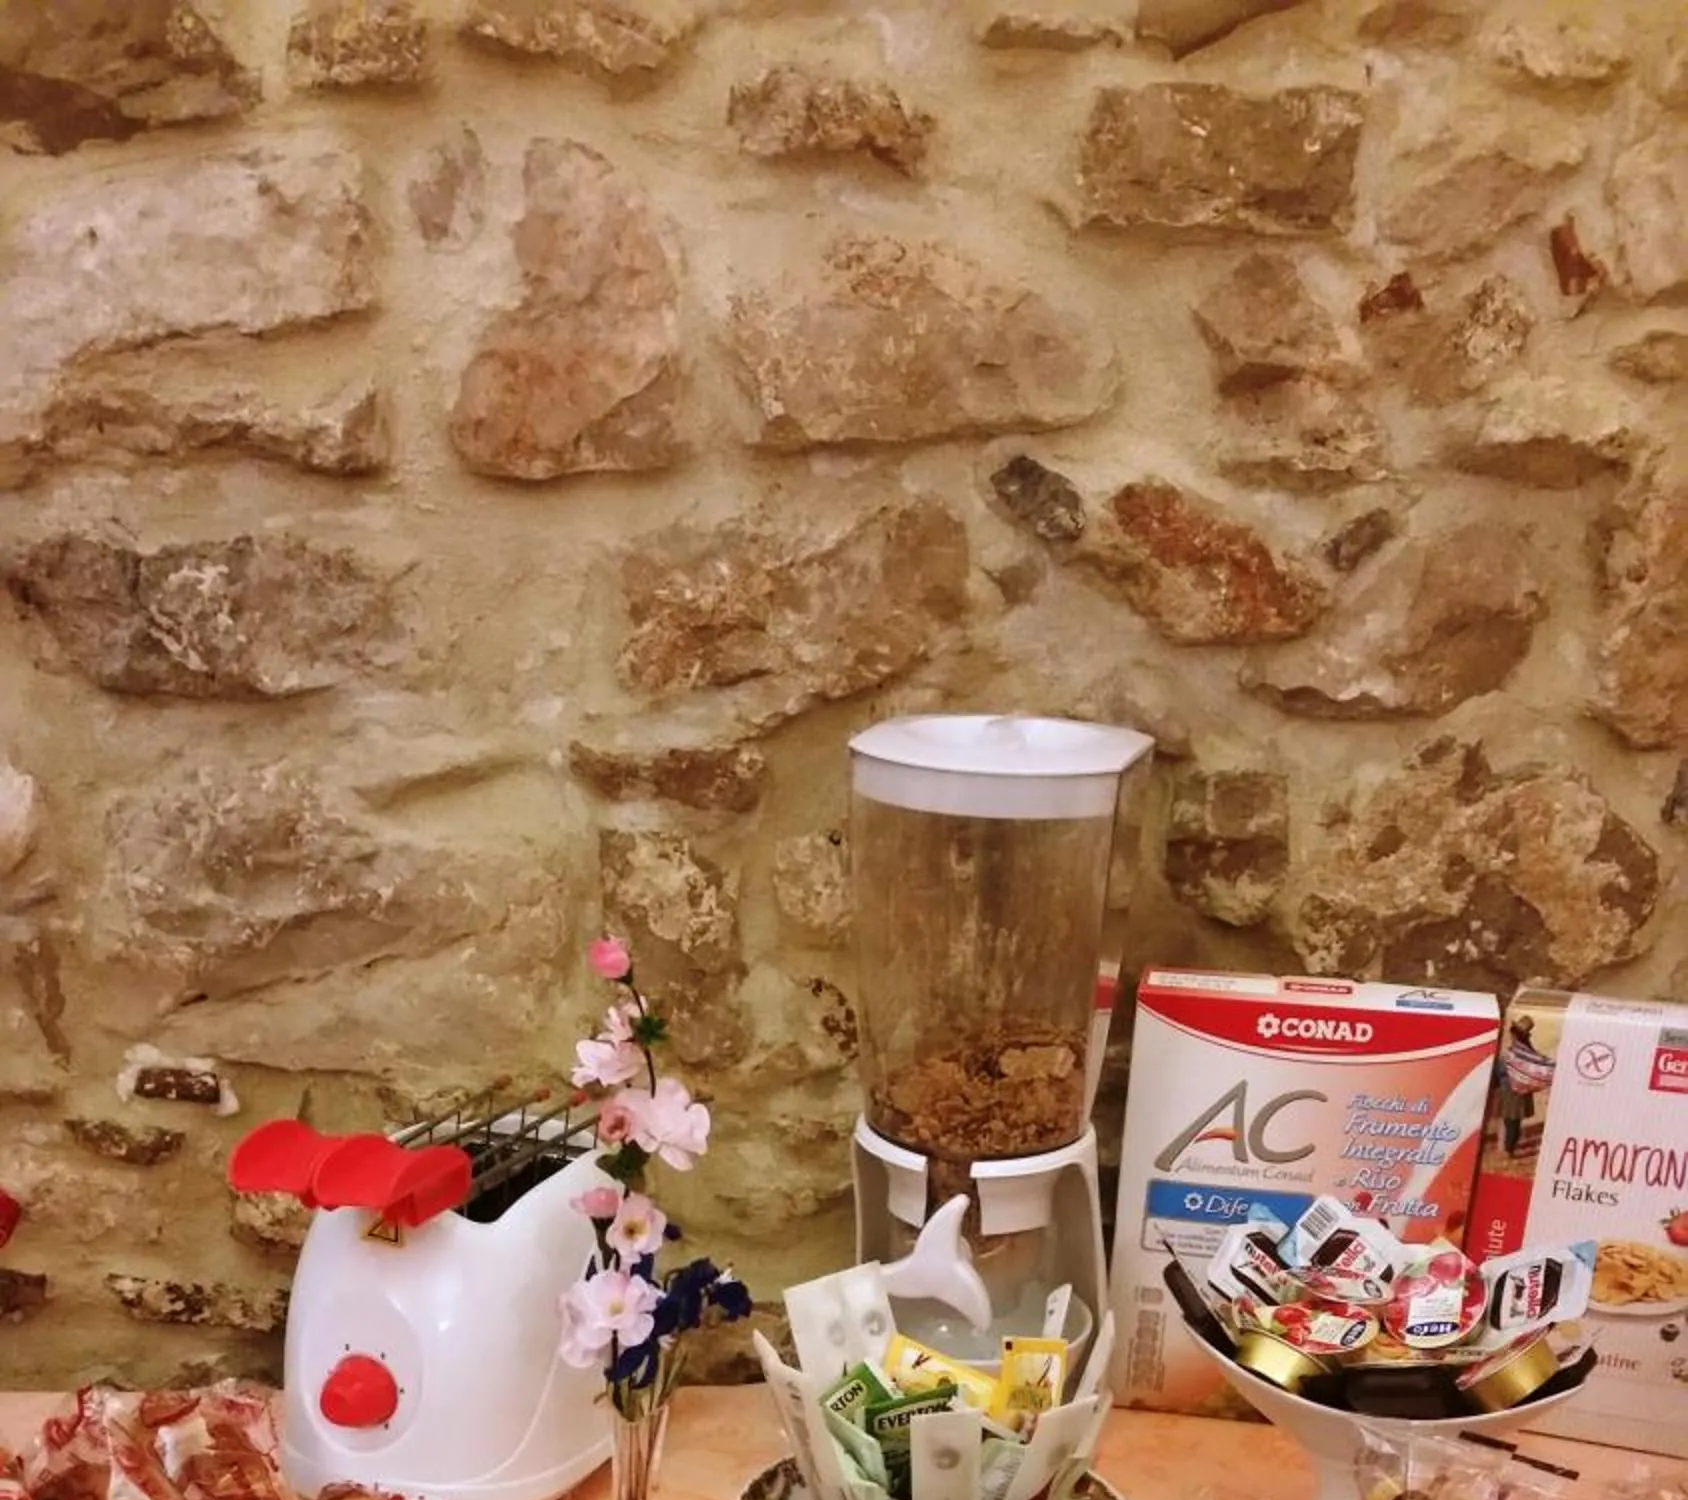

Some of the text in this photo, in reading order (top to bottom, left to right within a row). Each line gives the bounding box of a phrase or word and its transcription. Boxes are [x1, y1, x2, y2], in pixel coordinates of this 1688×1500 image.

[1281, 1015, 1373, 1043] CONAD
[1154, 1079, 1329, 1172] AC
[1344, 1113, 1460, 1142] Frumento
[1340, 1136, 1445, 1169] Integrale
[1349, 1167, 1402, 1190] Riso
[1551, 1179, 1620, 1206] Flakes
[1368, 1193, 1440, 1217] Frutta
